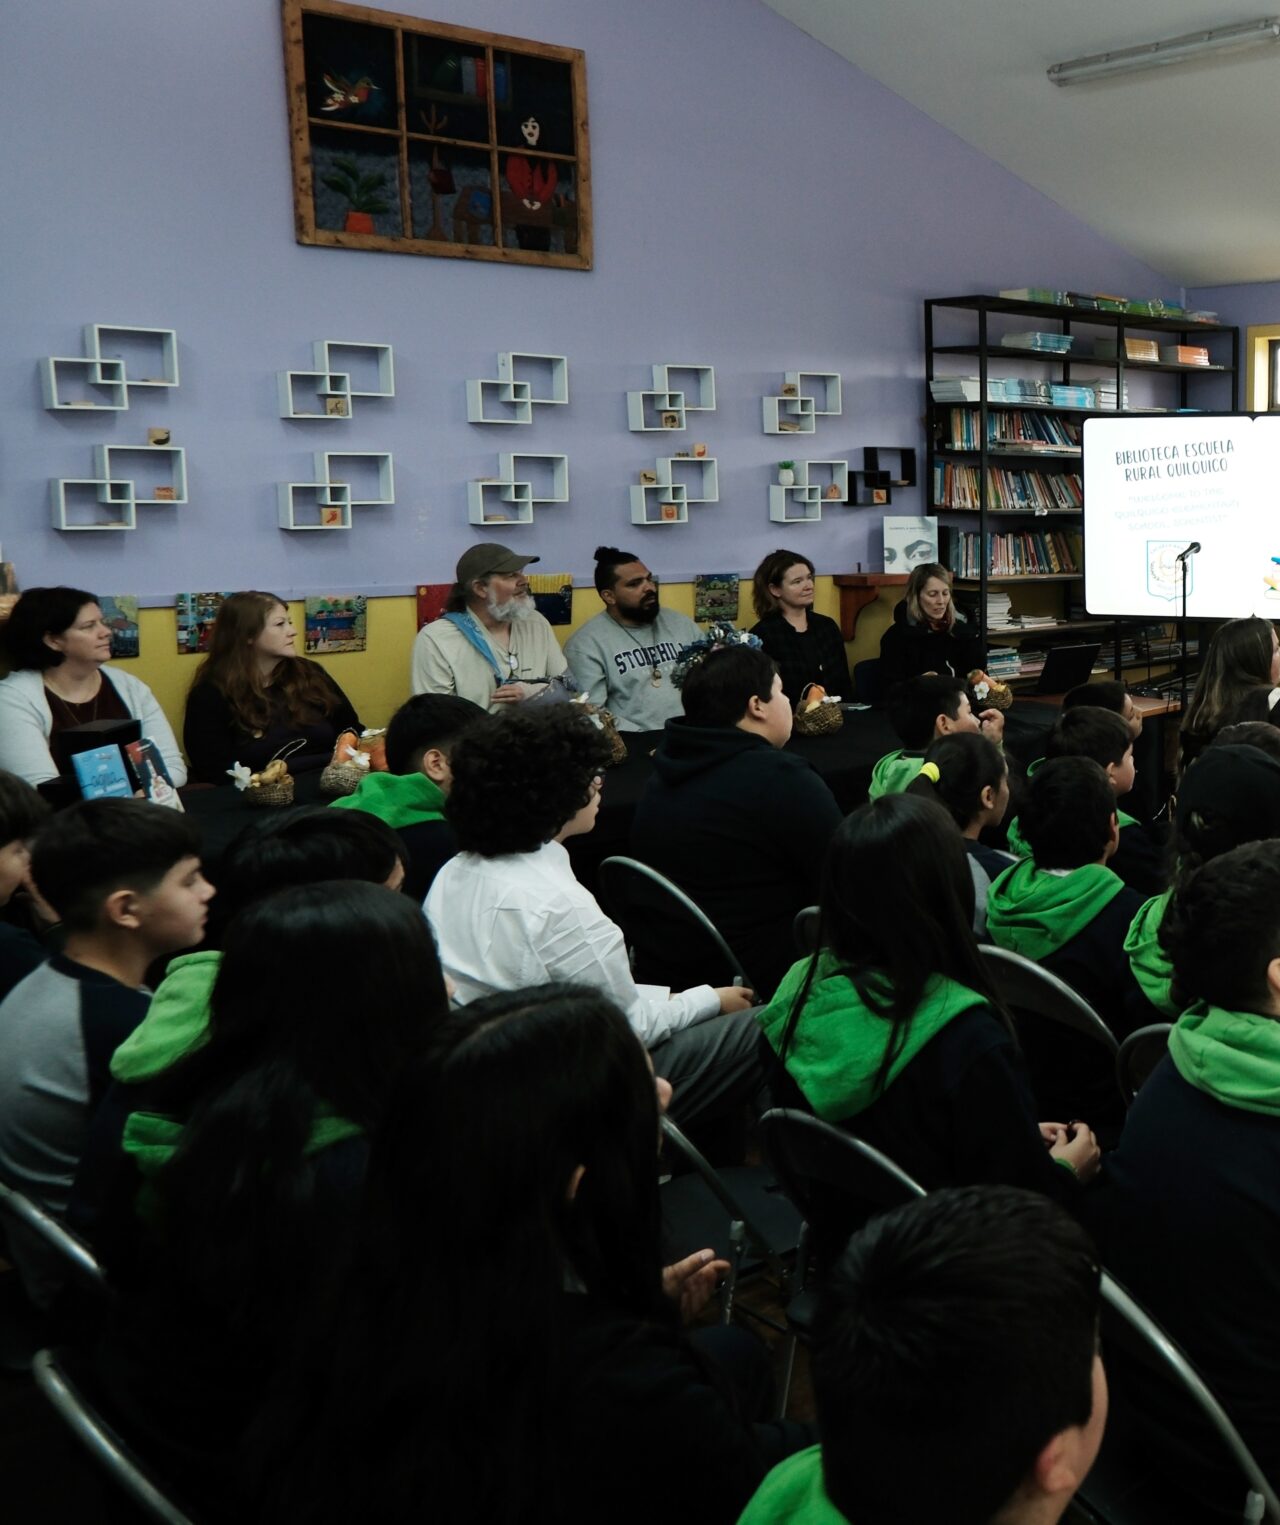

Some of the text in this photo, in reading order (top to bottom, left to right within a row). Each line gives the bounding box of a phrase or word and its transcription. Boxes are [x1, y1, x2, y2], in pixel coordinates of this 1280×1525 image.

[1115, 439, 1235, 466] BIBLIOTECA ESCUELA
[1124, 457, 1228, 482] RURAL QUILQUICO
